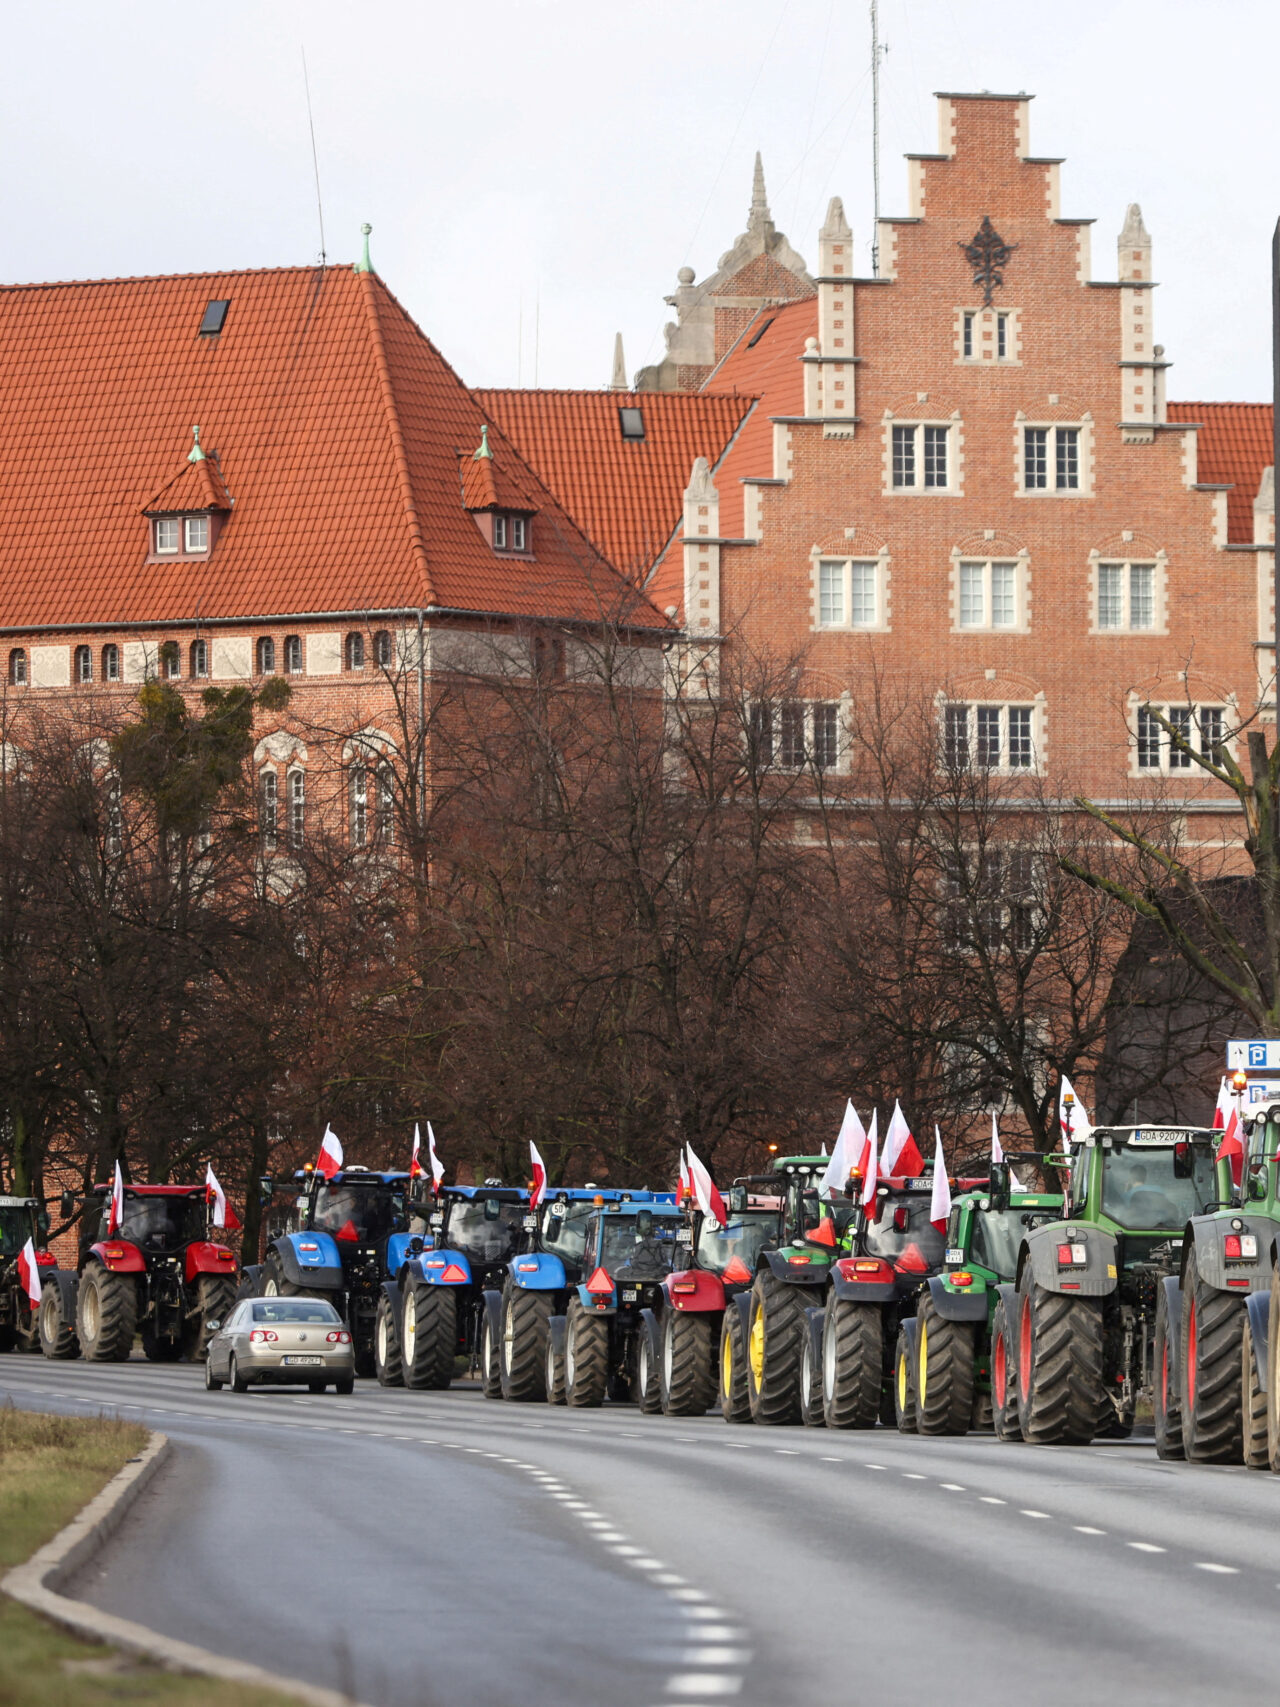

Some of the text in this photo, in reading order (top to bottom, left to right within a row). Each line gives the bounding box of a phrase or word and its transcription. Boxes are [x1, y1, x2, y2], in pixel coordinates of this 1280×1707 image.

[1141, 1131, 1185, 1141] GDA 92077
[554, 1204, 564, 1213] 50
